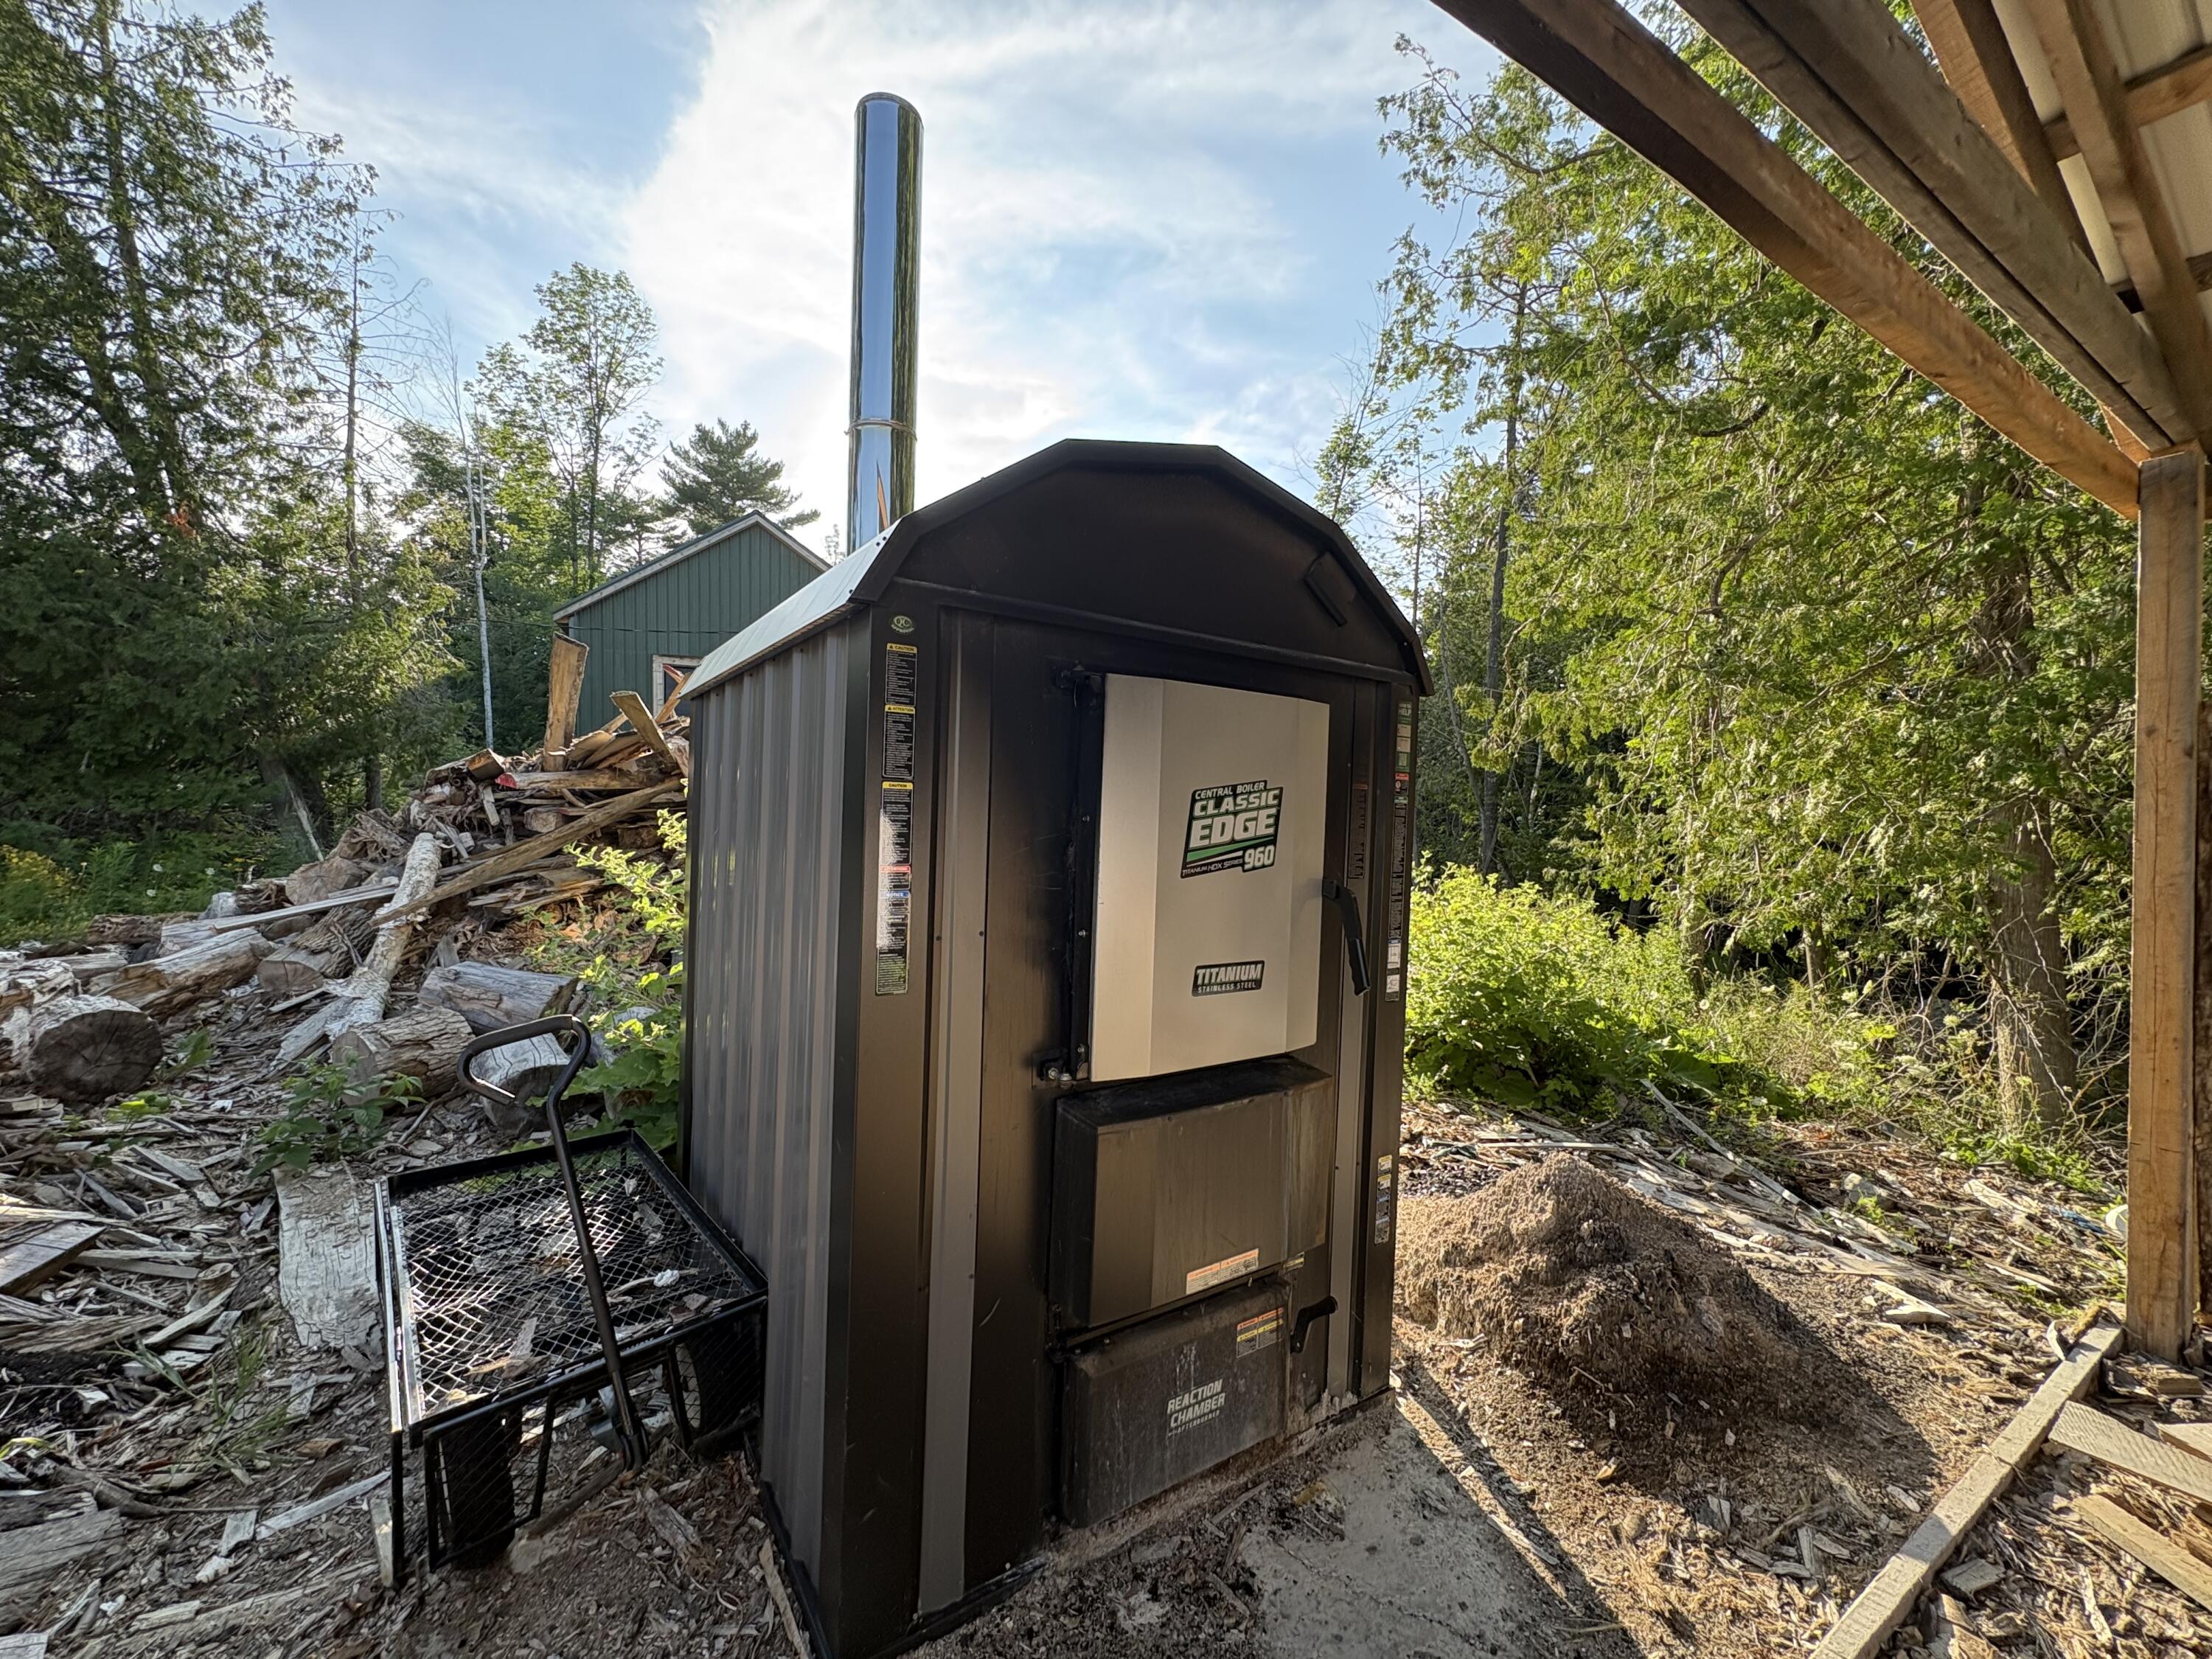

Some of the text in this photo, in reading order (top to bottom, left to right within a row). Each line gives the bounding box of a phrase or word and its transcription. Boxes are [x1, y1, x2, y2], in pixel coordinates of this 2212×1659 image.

[1398, 708, 1411, 716] HELP
[1194, 790, 1279, 816] CLASSIC
[1195, 782, 1265, 800] CENTRAL BOILER
[1189, 807, 1277, 848] EDGE
[1182, 866, 1208, 877] TITANIUM
[1208, 862, 1222, 872] HDX
[1244, 845, 1275, 870] 960
[1197, 964, 1262, 984] TITANIUM
[1197, 981, 1256, 994] STAINLESS STEEL
[1167, 1378, 1223, 1414] REACTION
[1170, 1392, 1226, 1427] CHAMBER
[1177, 1409, 1220, 1433] AFTERBURNER
